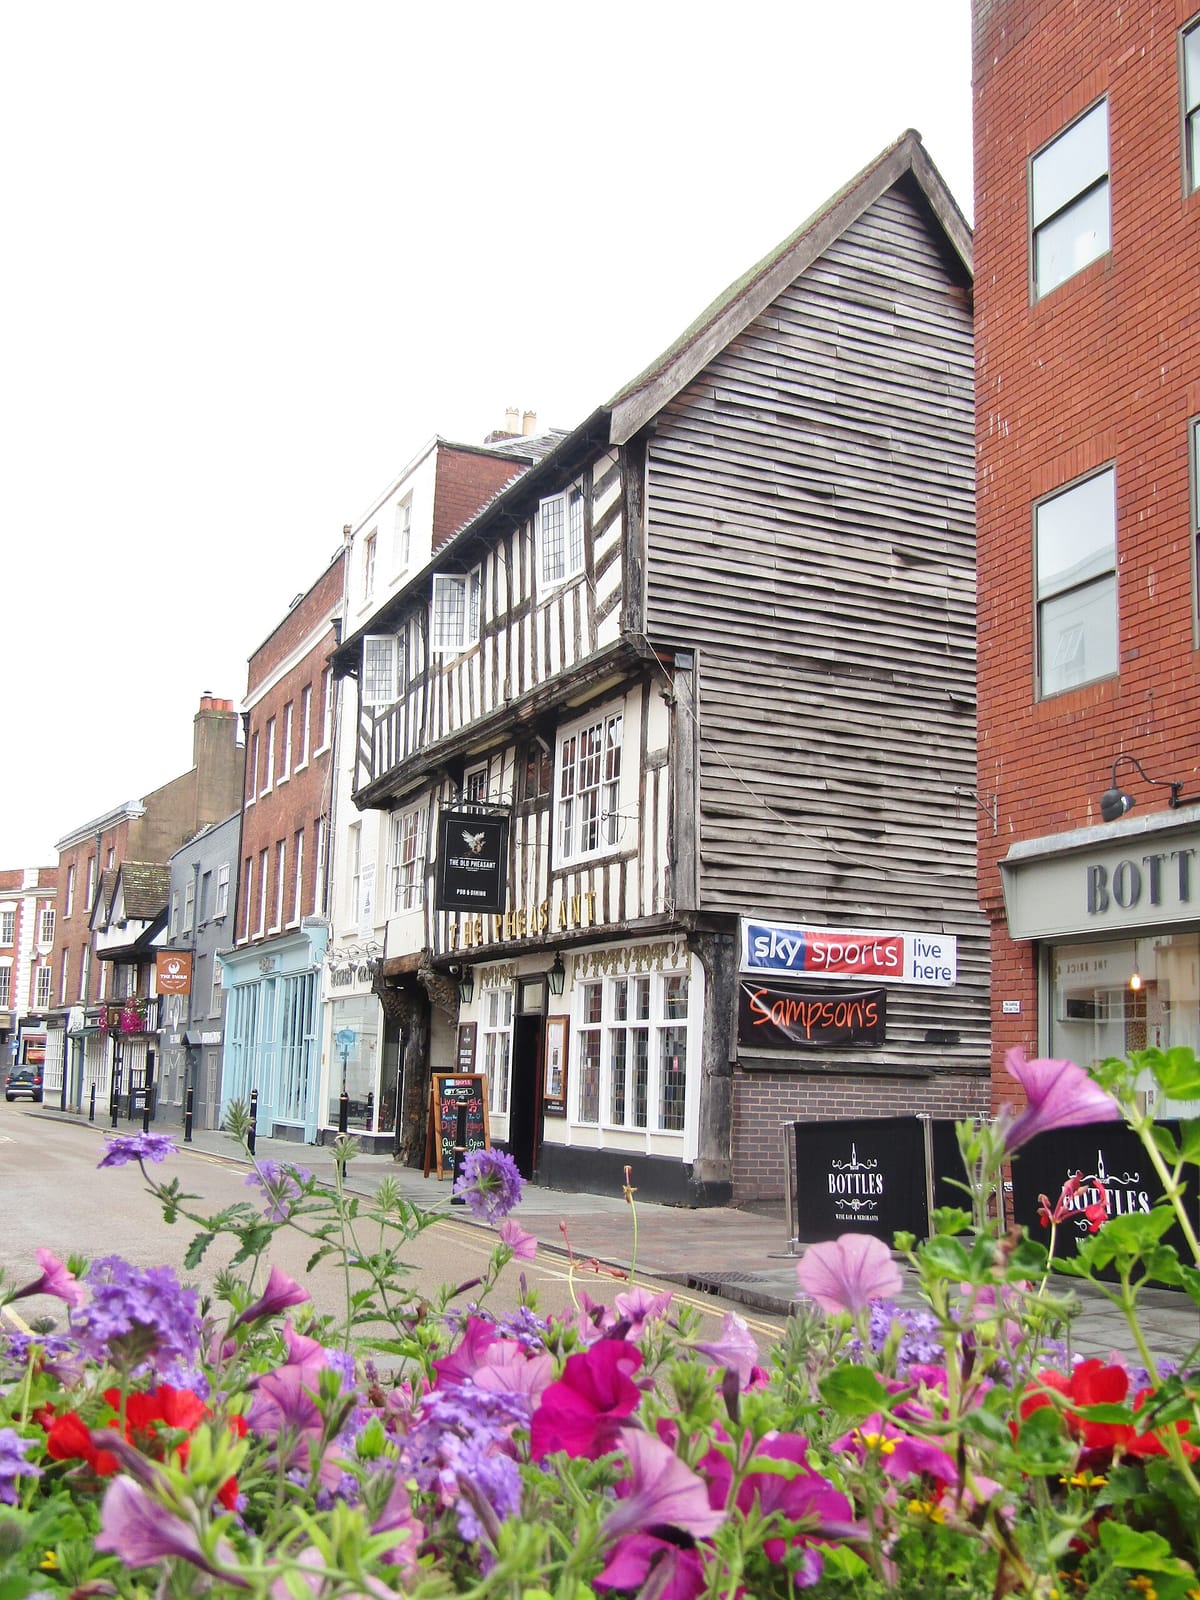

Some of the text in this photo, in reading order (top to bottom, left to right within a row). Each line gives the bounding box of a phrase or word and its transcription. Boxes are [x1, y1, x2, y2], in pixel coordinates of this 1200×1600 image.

[449, 858, 496, 869] THE OLD PHEASANT
[1087, 848, 1196, 915] BOTT
[450, 890, 597, 949] THE PHEASANT
[754, 931, 898, 968] sky sports
[913, 938, 942, 958] live
[913, 959, 952, 981] here
[750, 989, 878, 1039] Sampson's
[828, 1173, 883, 1194] BOTTLES
